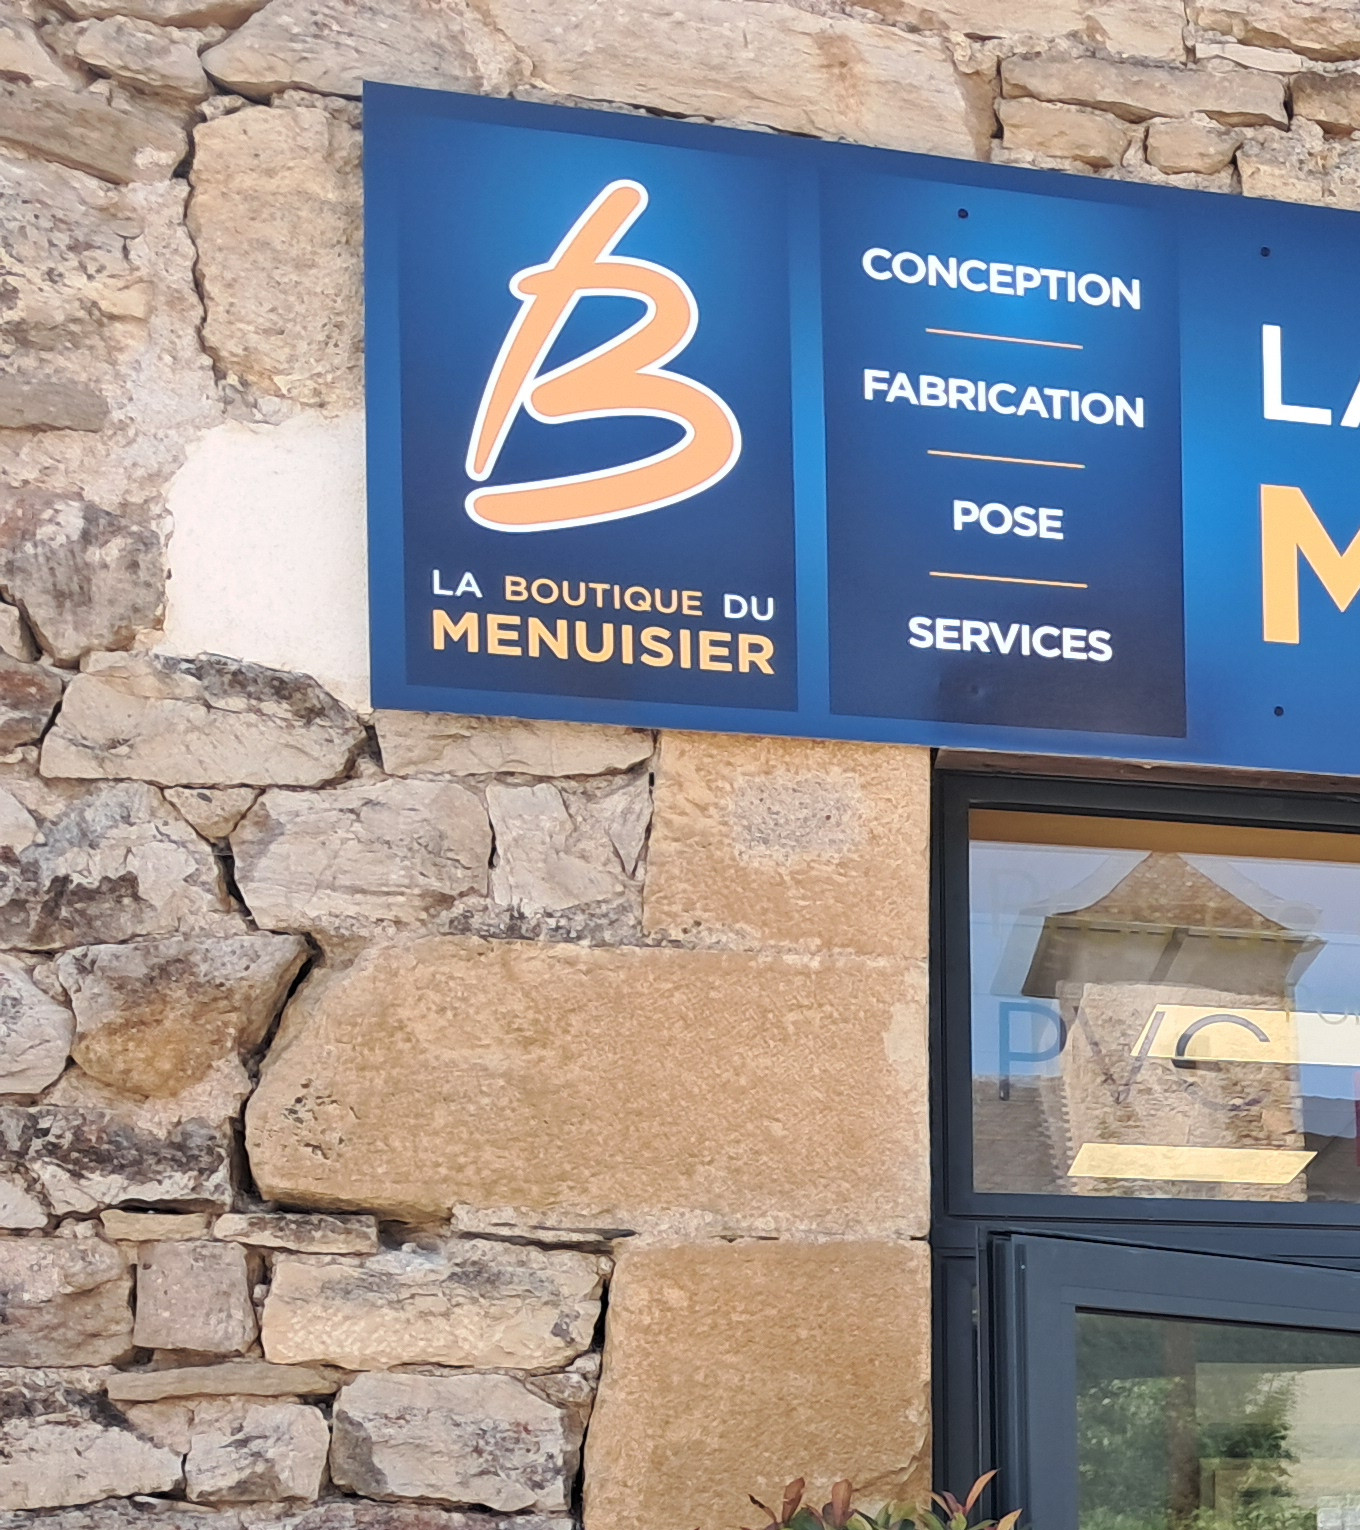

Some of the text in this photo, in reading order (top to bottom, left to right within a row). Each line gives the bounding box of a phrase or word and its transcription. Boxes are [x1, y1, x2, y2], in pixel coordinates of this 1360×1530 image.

[861, 246, 1143, 312] CONCEPTION
[863, 368, 1146, 430] FABRICATION
[952, 499, 1065, 541] POSE
[432, 568, 776, 623] LA BOUTIQUE DU
[432, 609, 776, 677] MENUISIER
[907, 614, 1114, 664] SERVICES
[998, 1001, 1270, 1112] PVC
